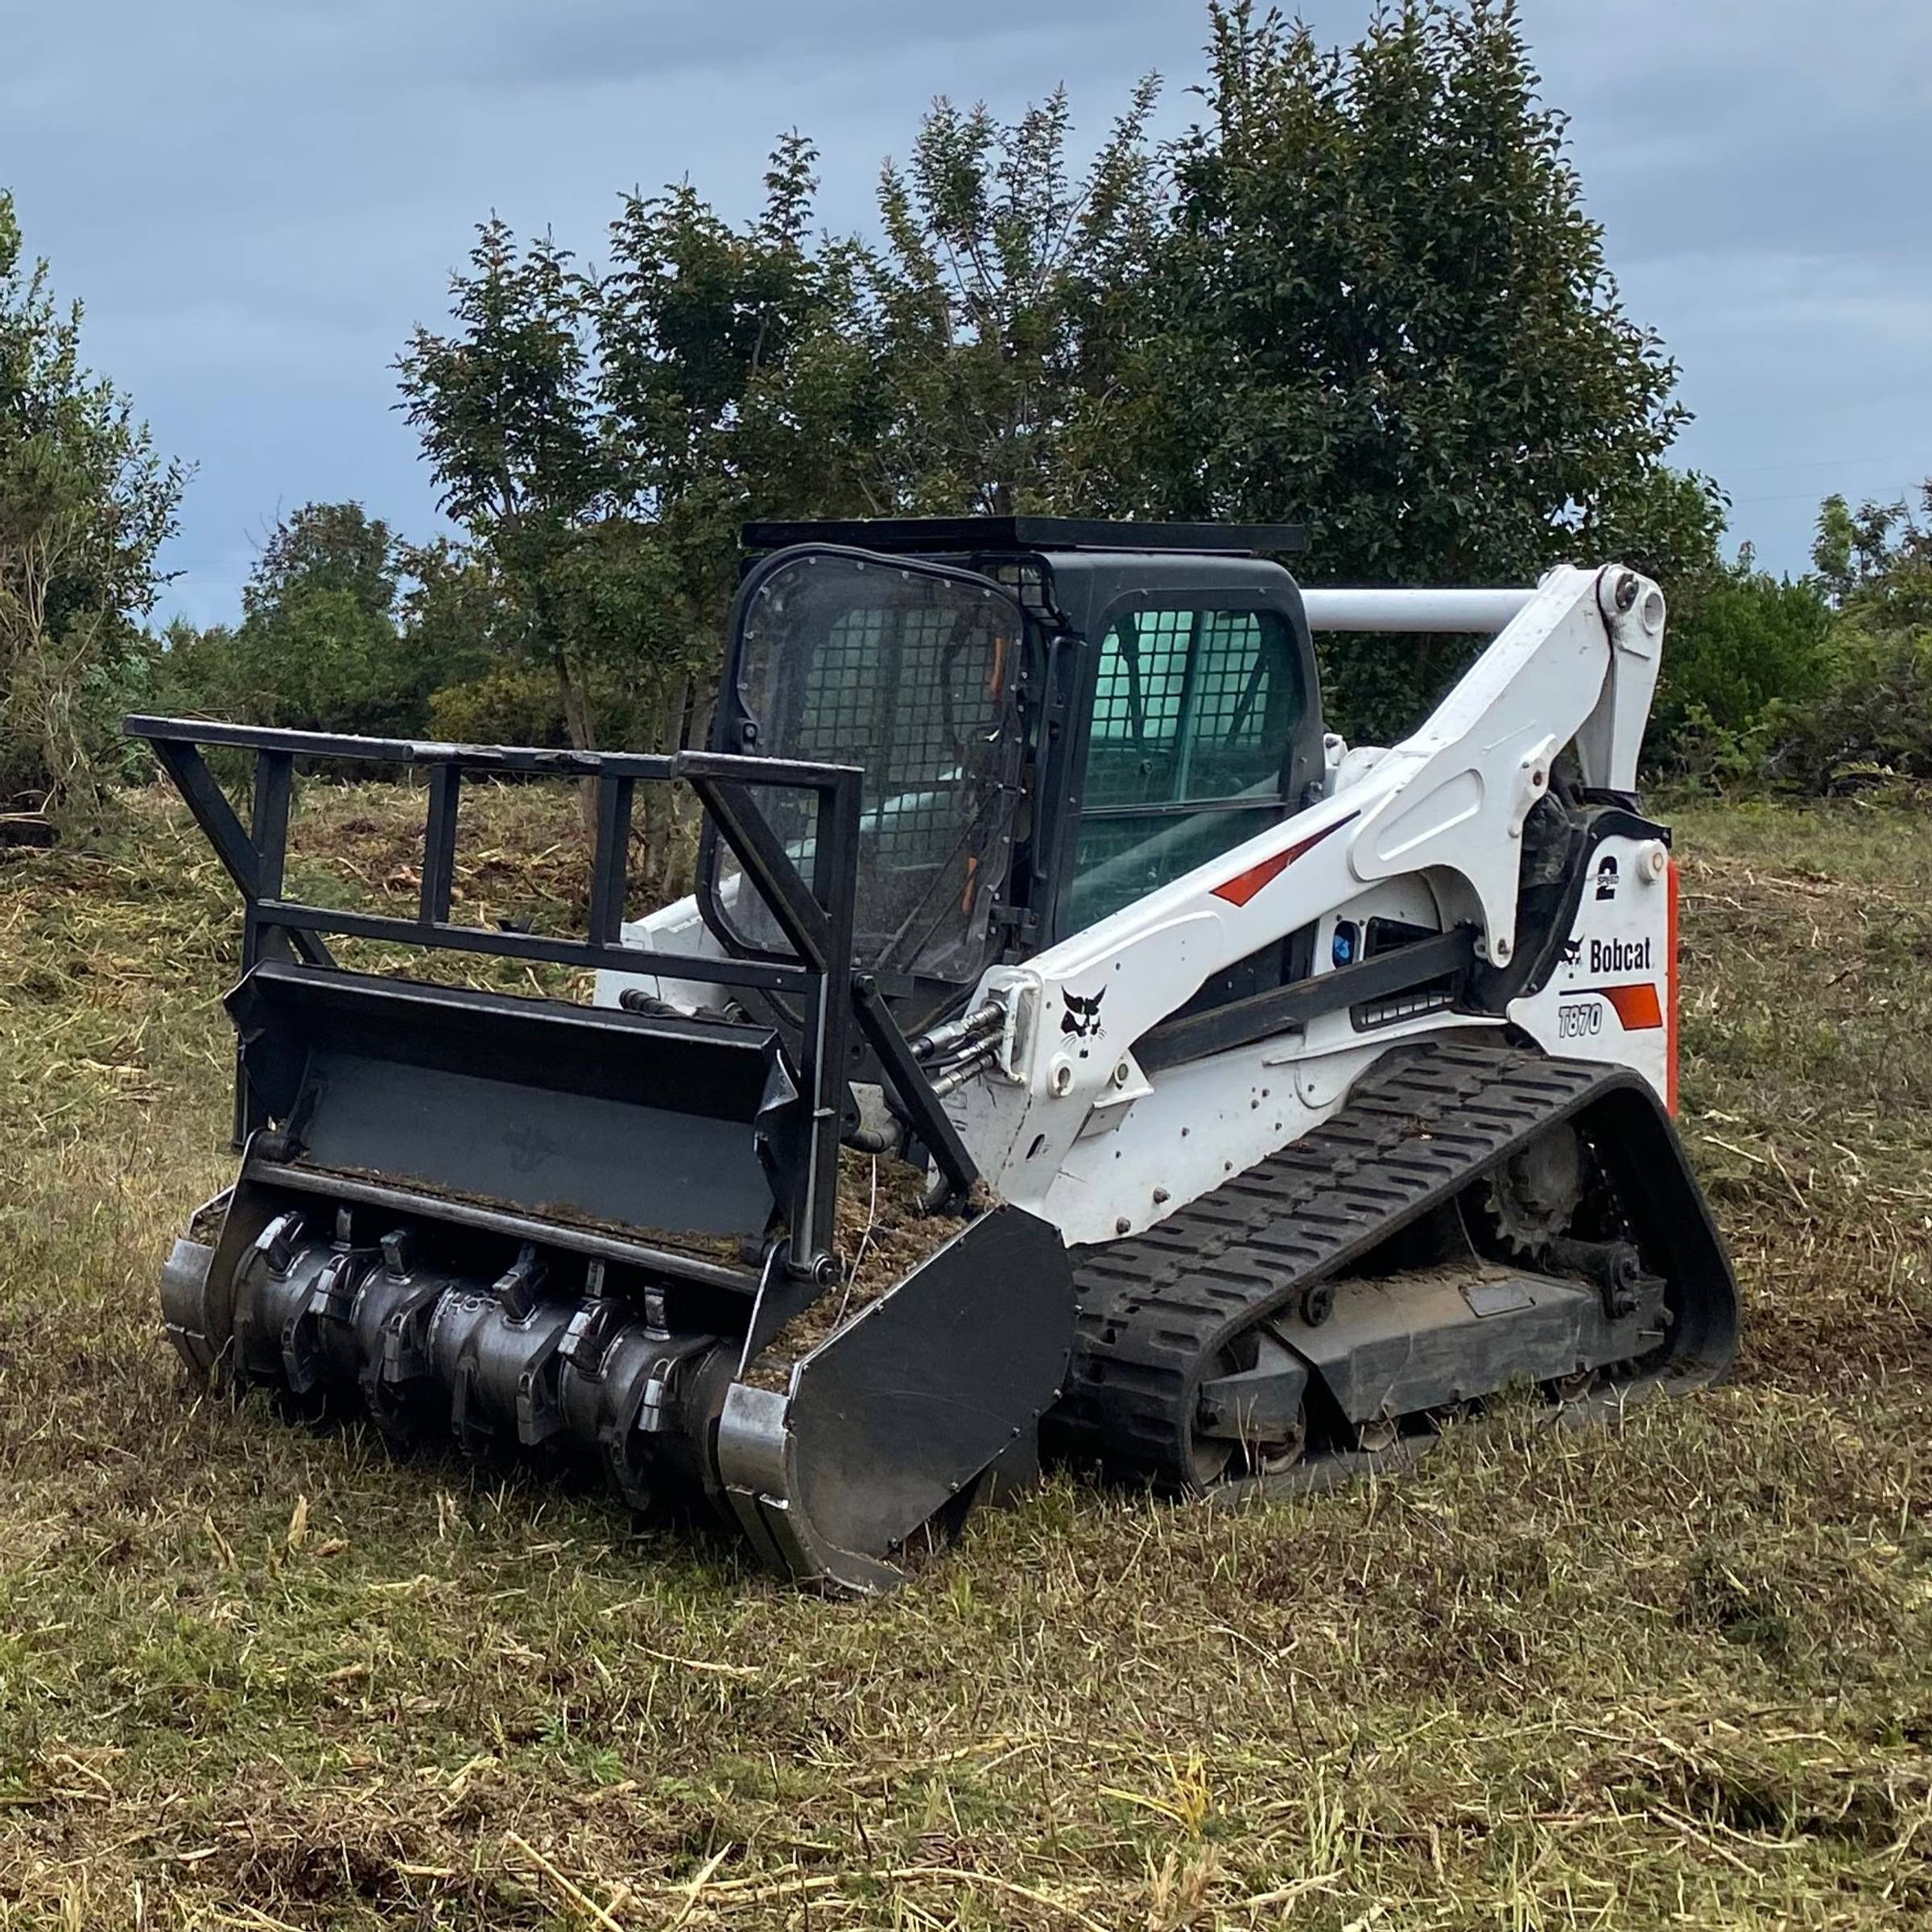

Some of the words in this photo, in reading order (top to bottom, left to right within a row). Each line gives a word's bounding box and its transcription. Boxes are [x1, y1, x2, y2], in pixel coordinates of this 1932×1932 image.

[1596, 855, 1618, 901] 2
[1590, 937, 1650, 973] Bobcat
[1558, 1003, 1602, 1038] T870
